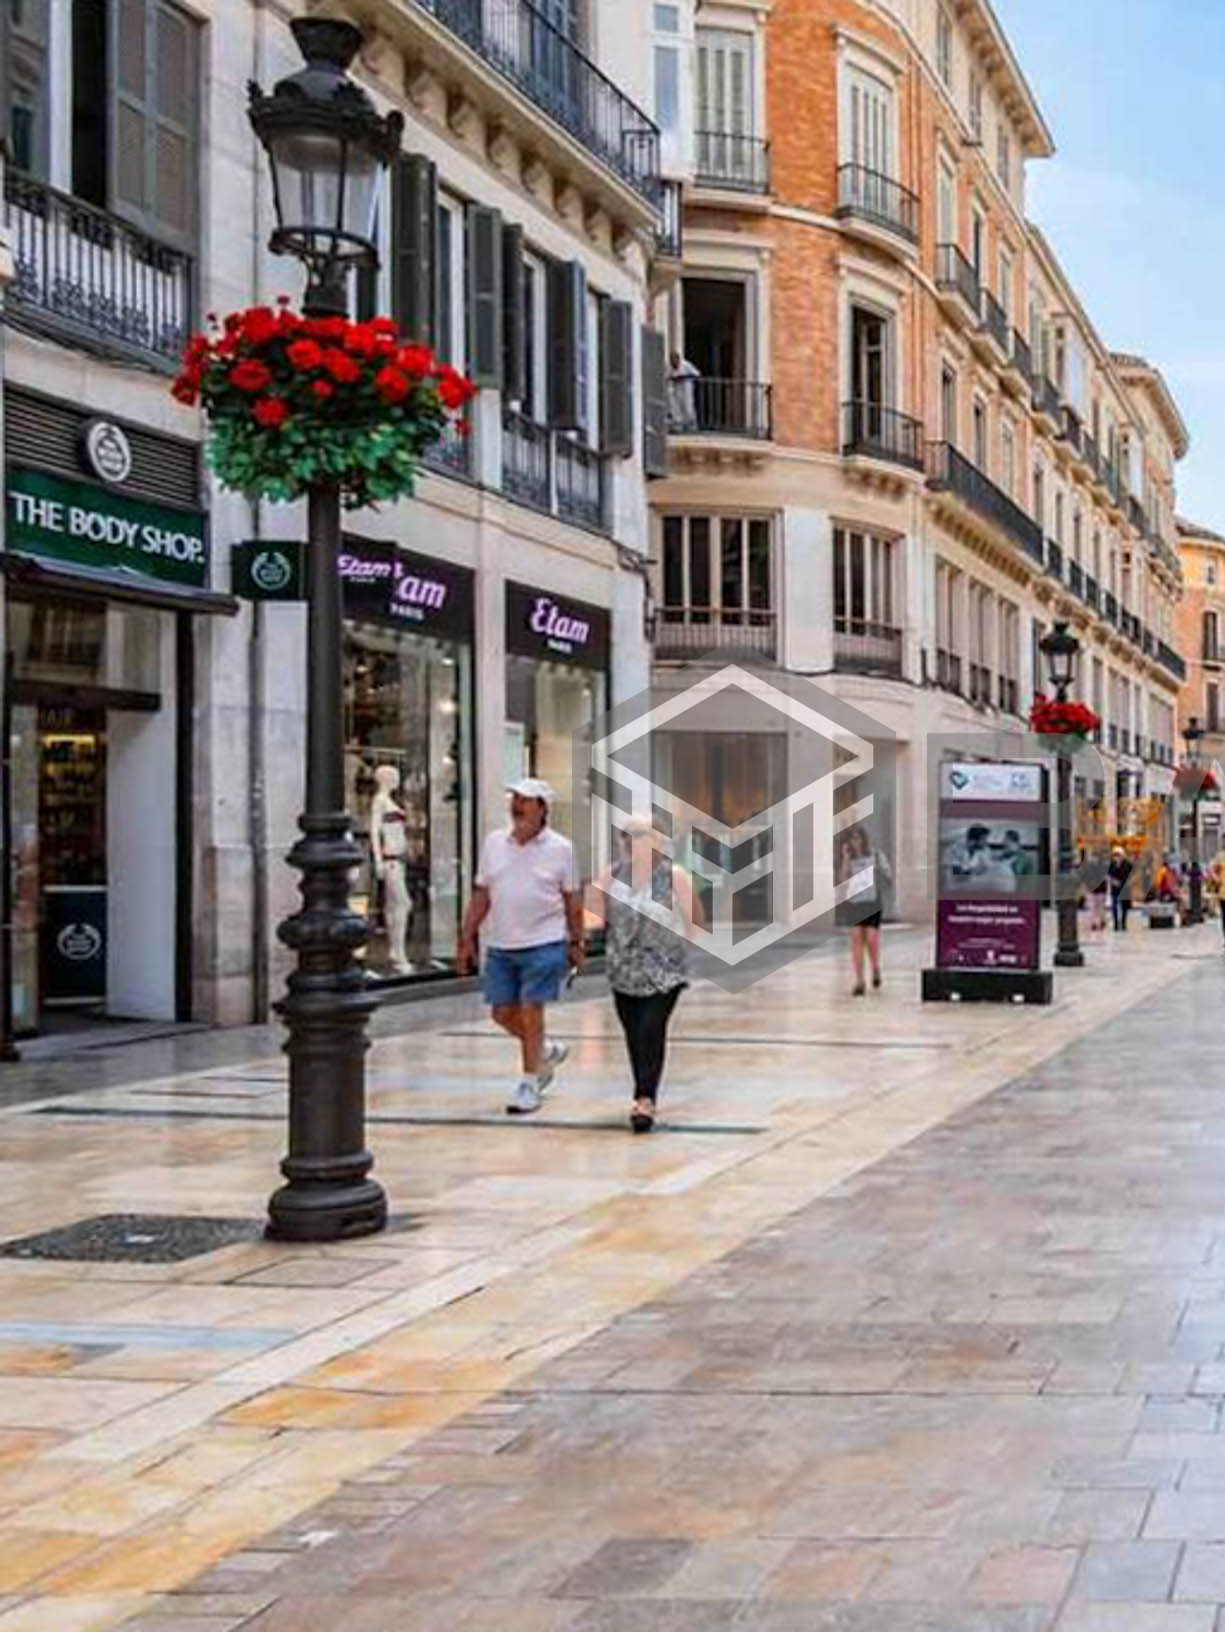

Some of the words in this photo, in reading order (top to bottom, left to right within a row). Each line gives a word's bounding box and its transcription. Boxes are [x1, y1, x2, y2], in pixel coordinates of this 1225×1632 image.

[9, 491, 64, 533] THE
[69, 507, 139, 548] BODY
[531, 598, 589, 643] Etam
